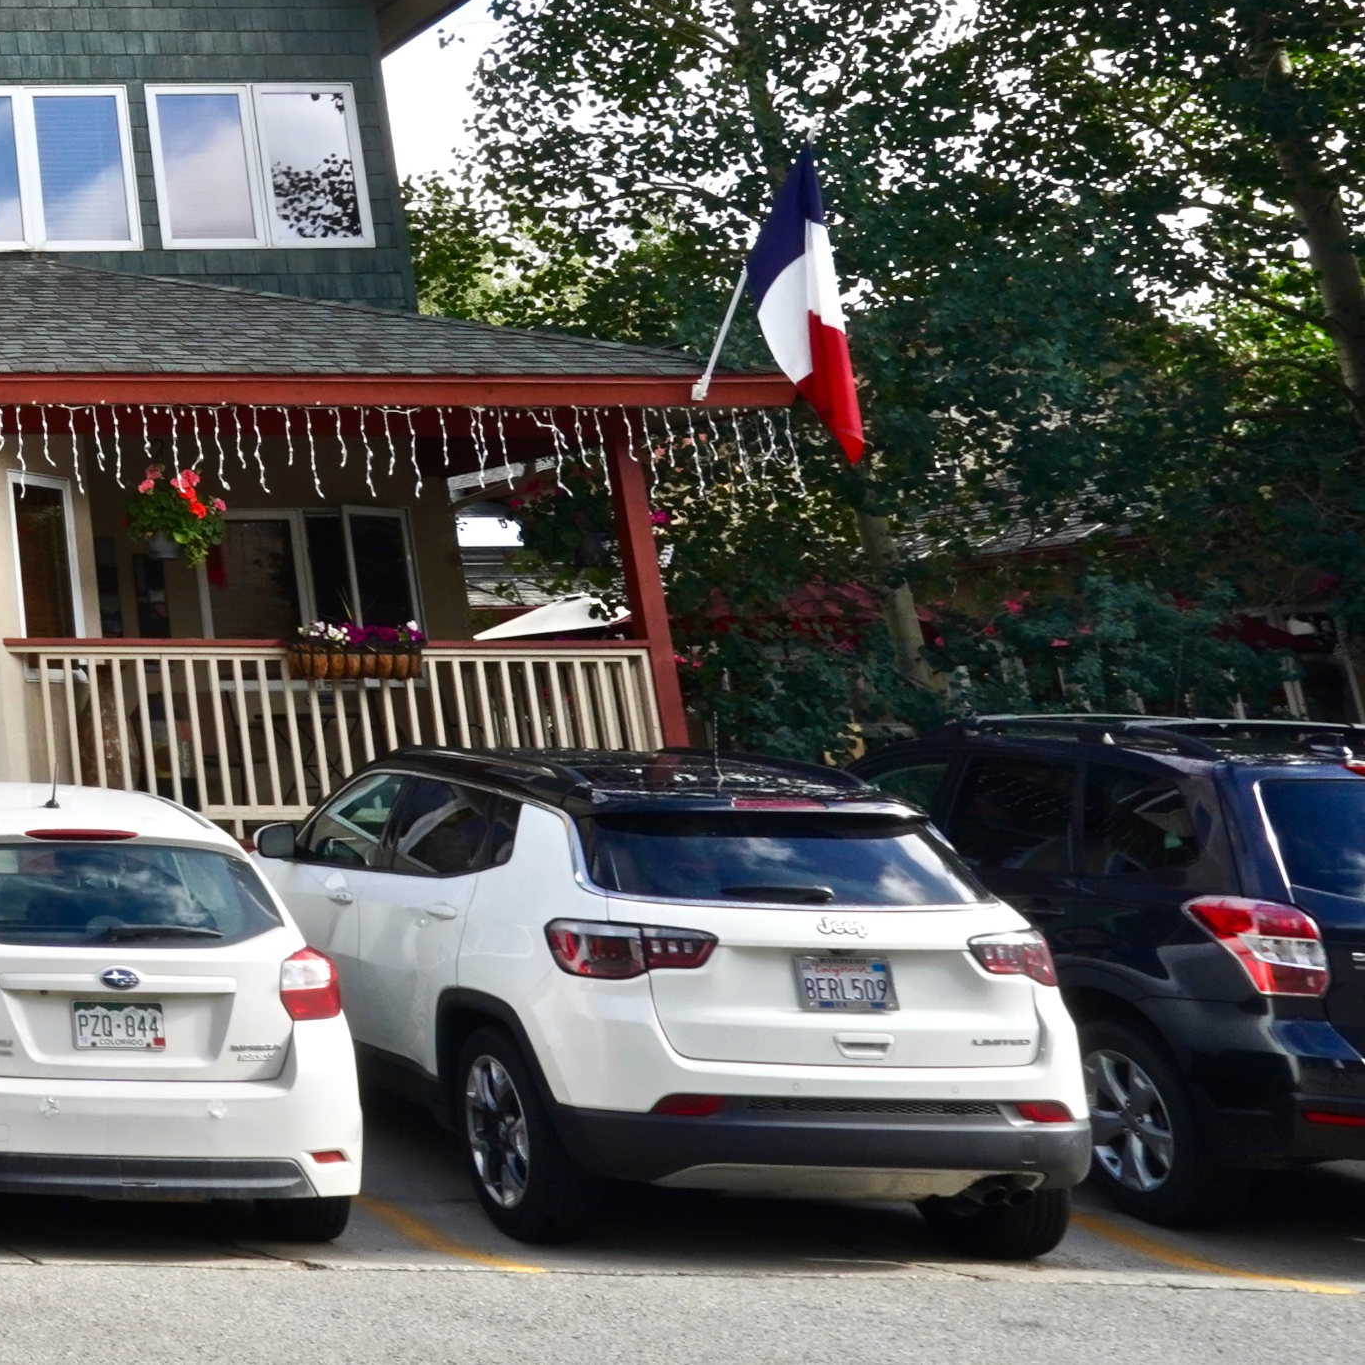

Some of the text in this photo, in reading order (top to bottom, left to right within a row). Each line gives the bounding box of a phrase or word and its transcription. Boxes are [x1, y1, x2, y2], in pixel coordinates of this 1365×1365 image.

[816, 916, 869, 939] Jeep
[804, 977, 888, 1001] 8ERL509
[99, 1038, 144, 1046] COLORADO
